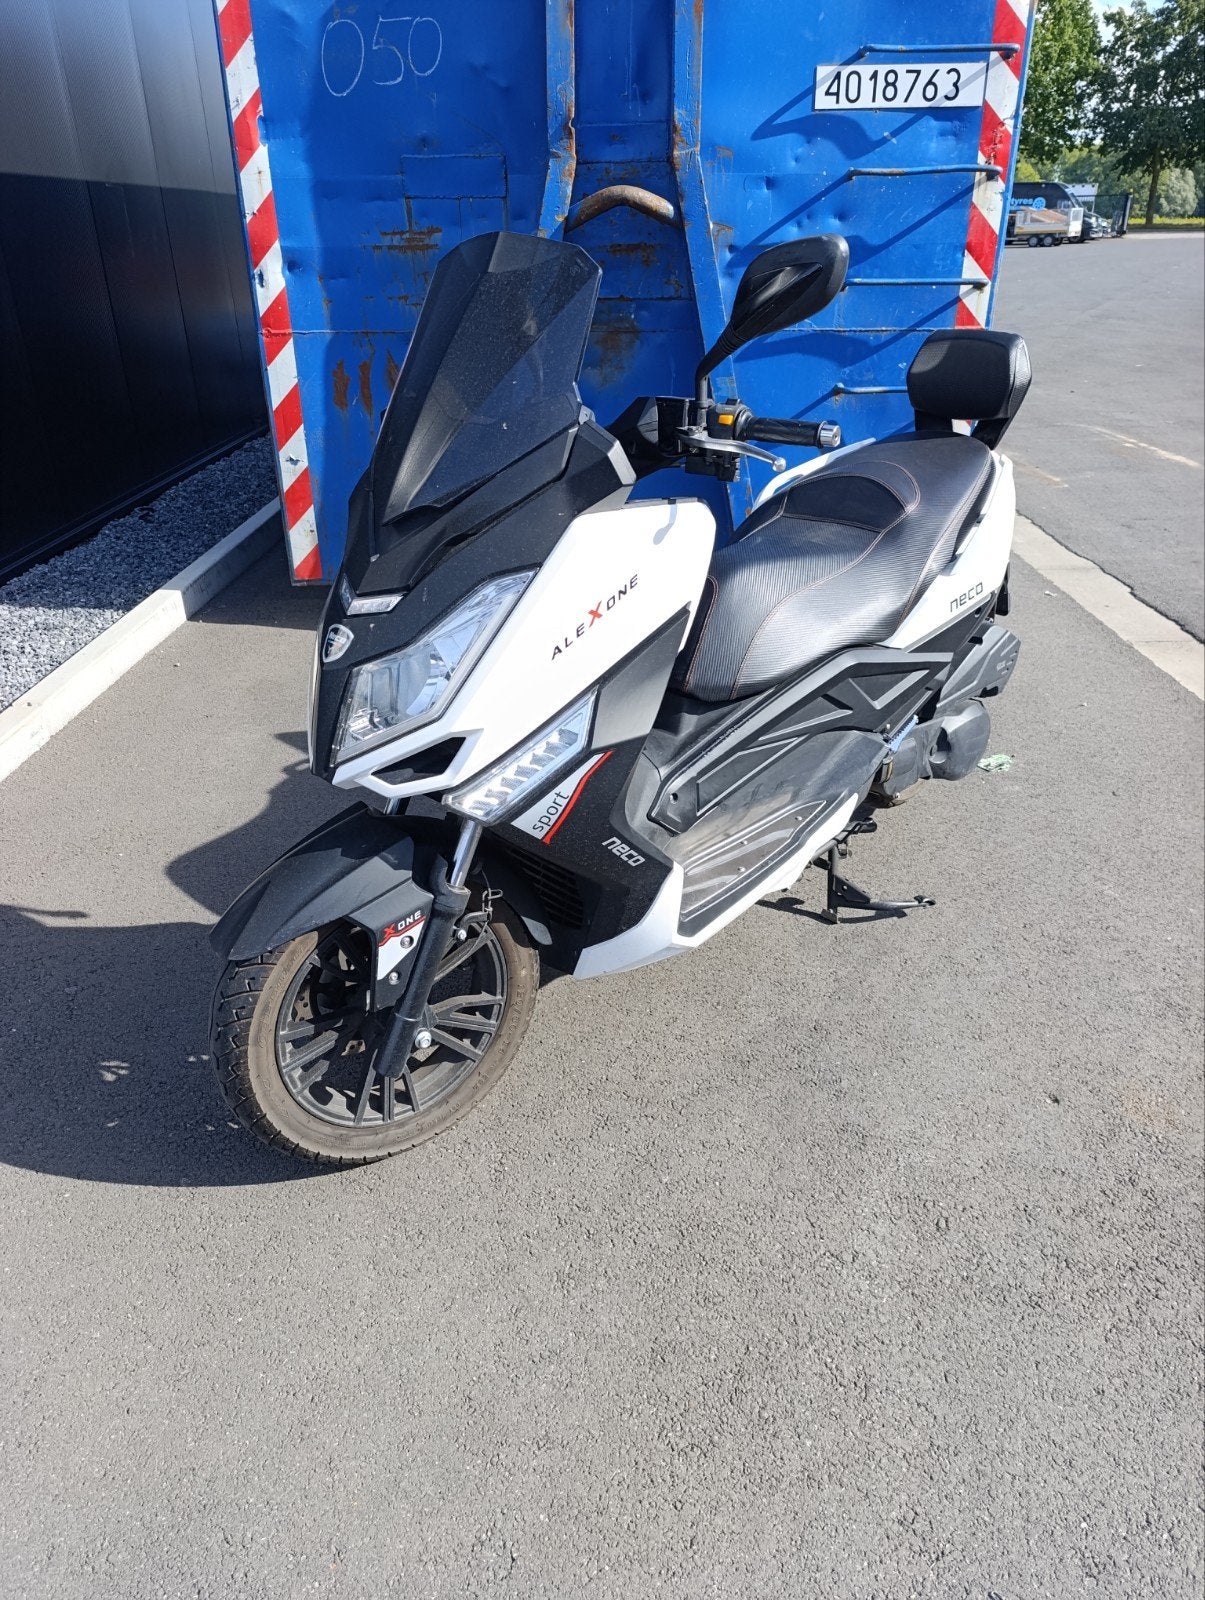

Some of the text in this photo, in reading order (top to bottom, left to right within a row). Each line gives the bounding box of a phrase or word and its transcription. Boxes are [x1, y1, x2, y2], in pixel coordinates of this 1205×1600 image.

[321, 15, 443, 97] 050
[825, 68, 961, 104] 4018763
[532, 791, 569, 832] sport
